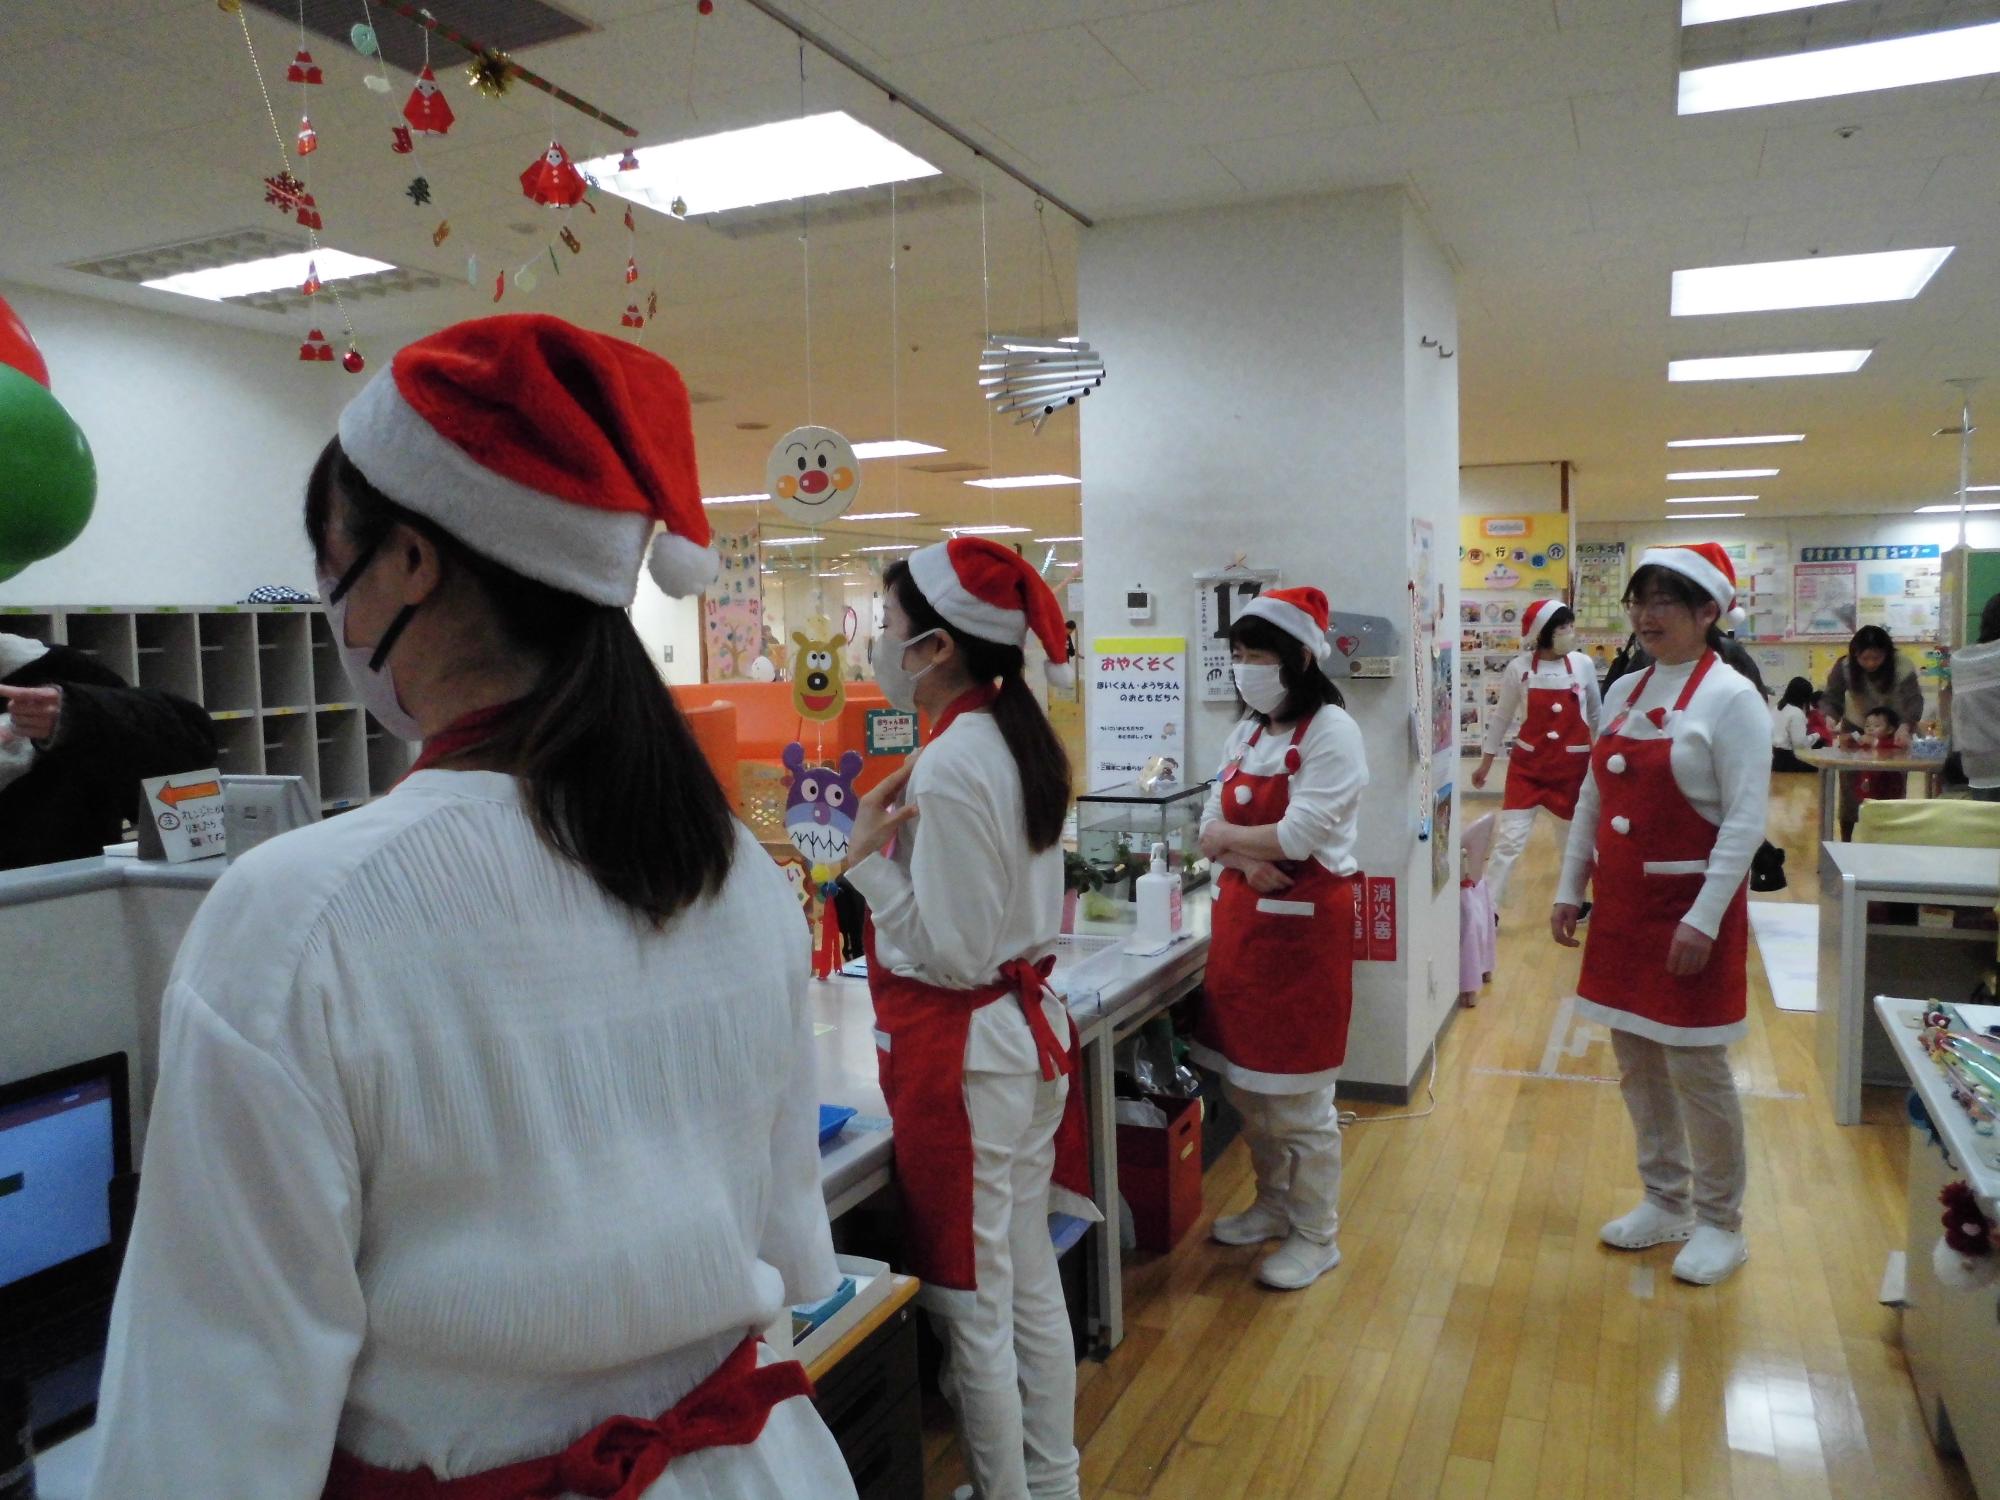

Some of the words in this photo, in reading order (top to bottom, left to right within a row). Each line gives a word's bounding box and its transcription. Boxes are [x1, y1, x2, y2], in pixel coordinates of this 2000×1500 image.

[1101, 656, 1175, 672] おやくそく
[1120, 694, 1180, 702] のおともだちへ
[1373, 883, 1392, 940] 消火器
